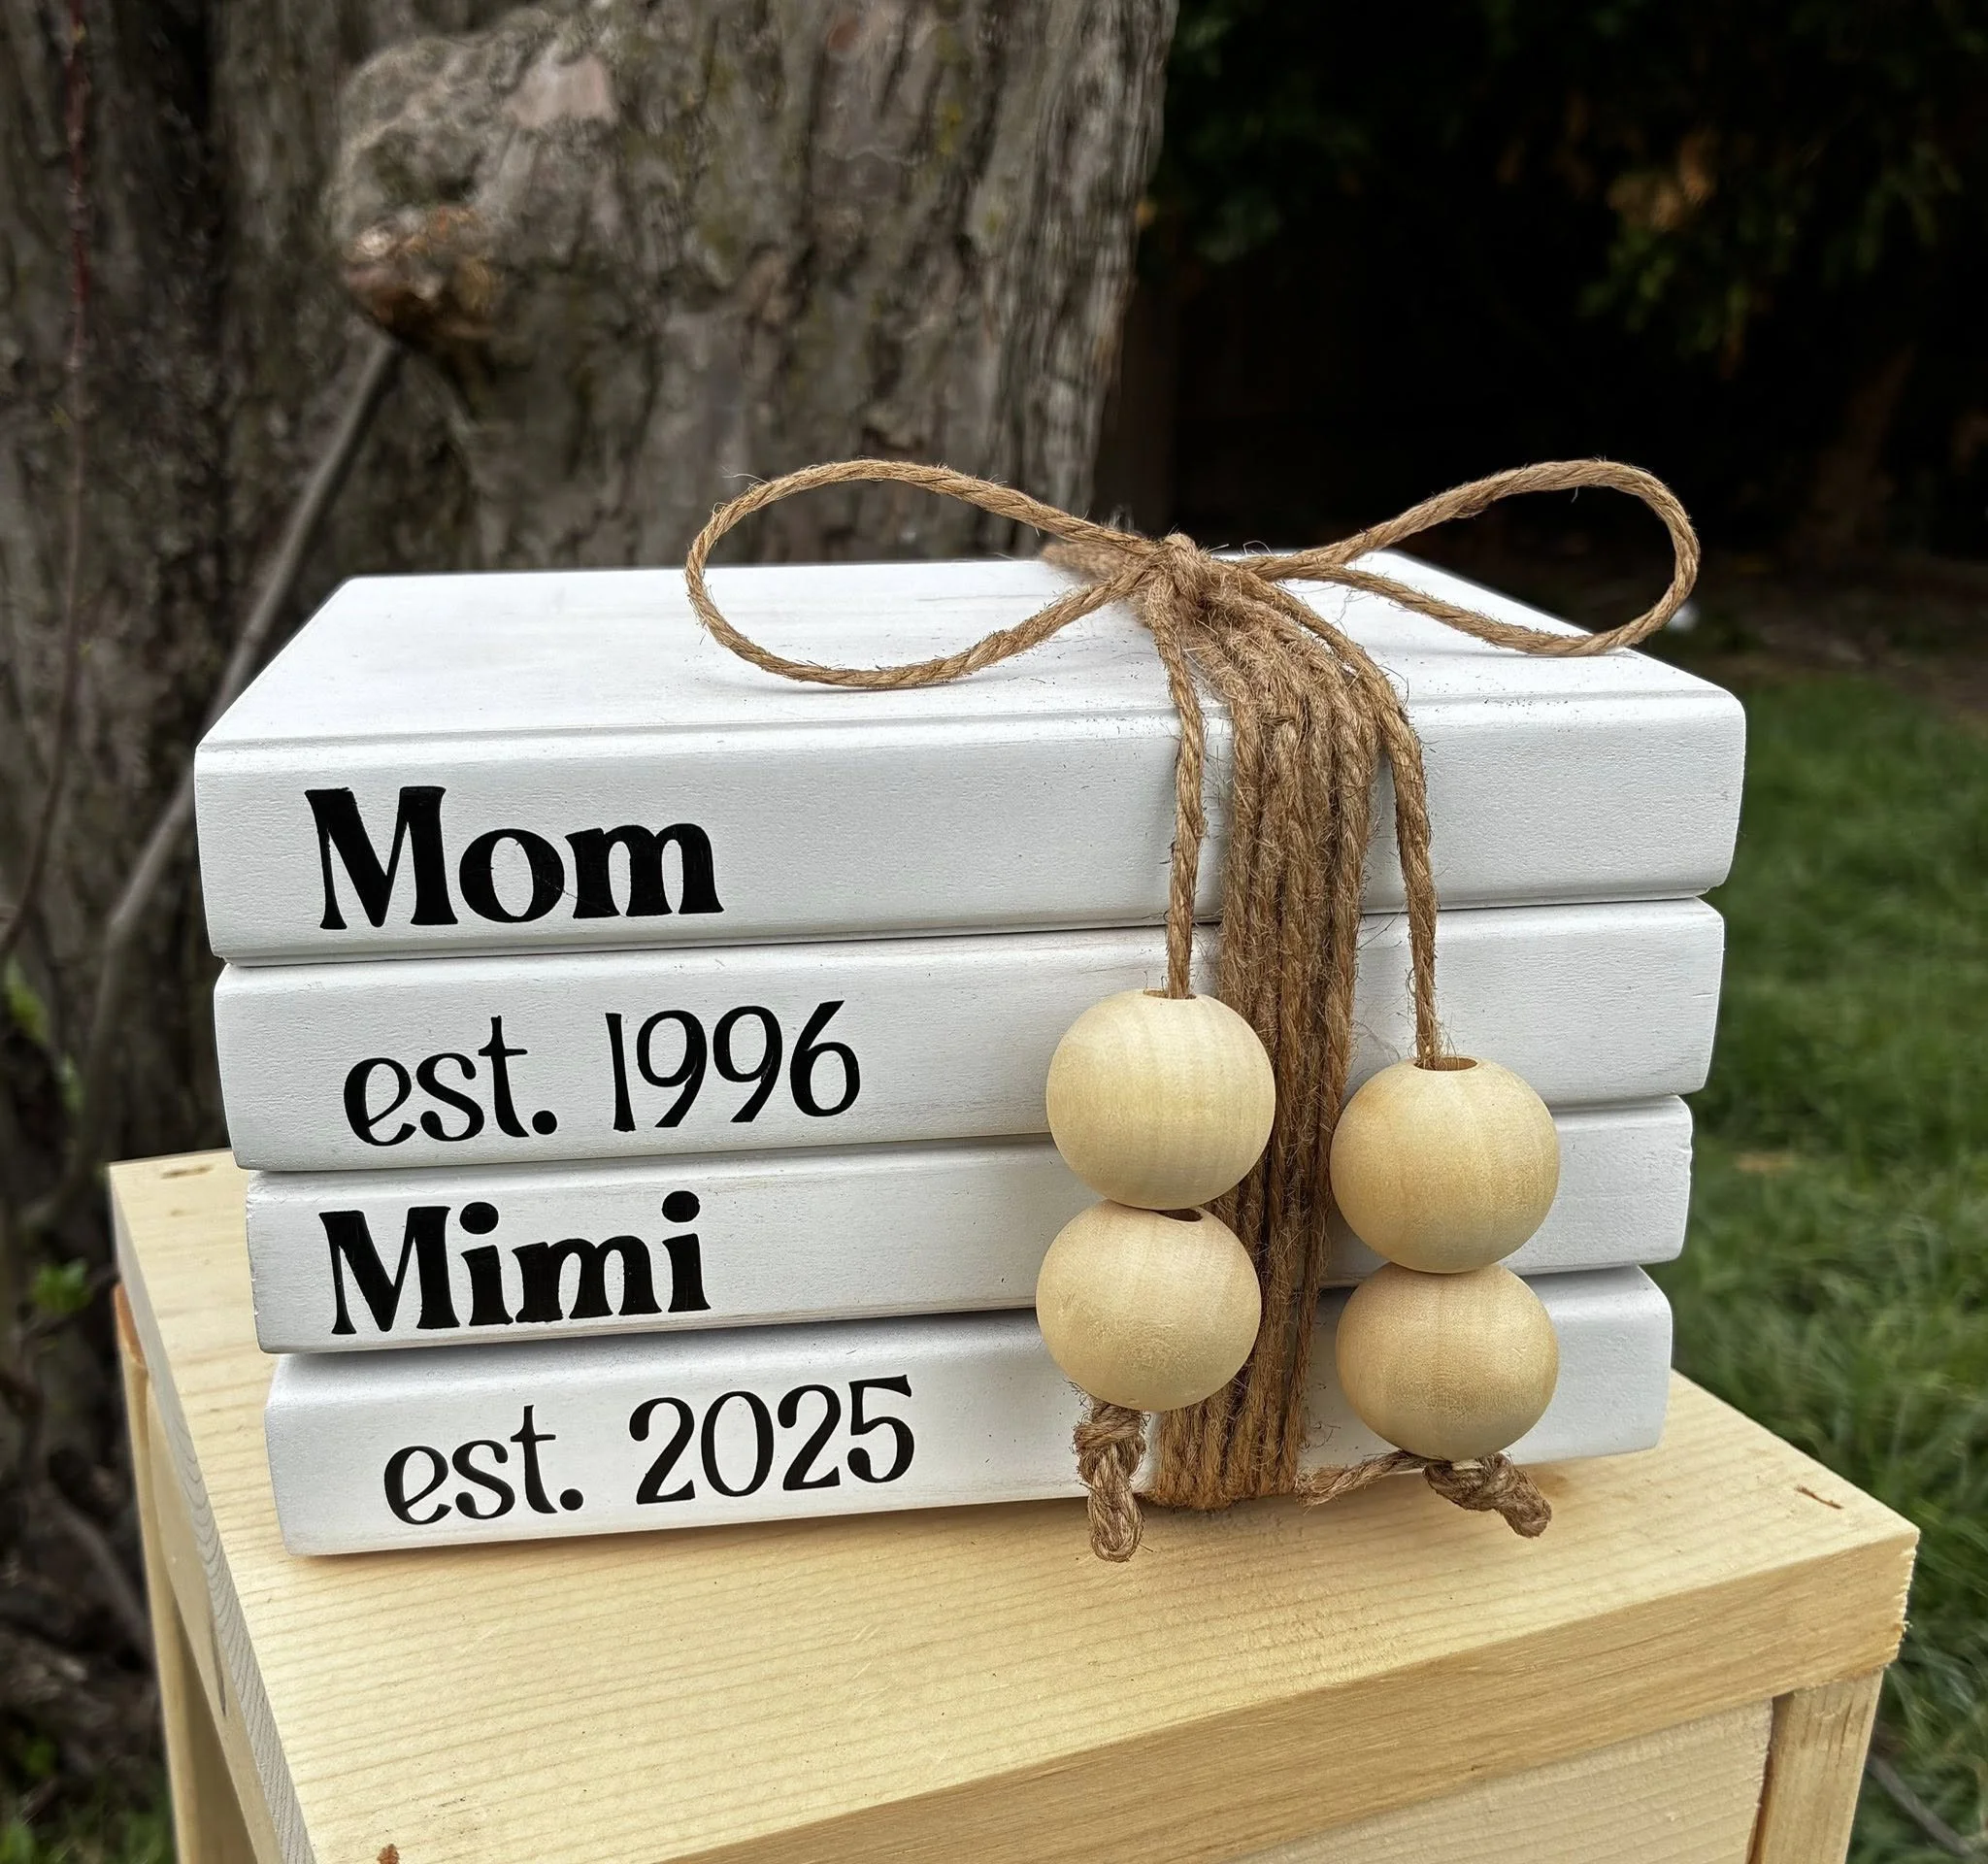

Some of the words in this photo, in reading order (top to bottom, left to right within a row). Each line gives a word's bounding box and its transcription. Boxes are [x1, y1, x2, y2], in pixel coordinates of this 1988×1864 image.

[305, 785, 725, 930] Mom
[343, 1015, 558, 1147] est.
[605, 1000, 861, 1133] 1996
[318, 1190, 712, 1336] Mimi
[383, 1404, 584, 1525] est.
[629, 1374, 915, 1505] 2025
